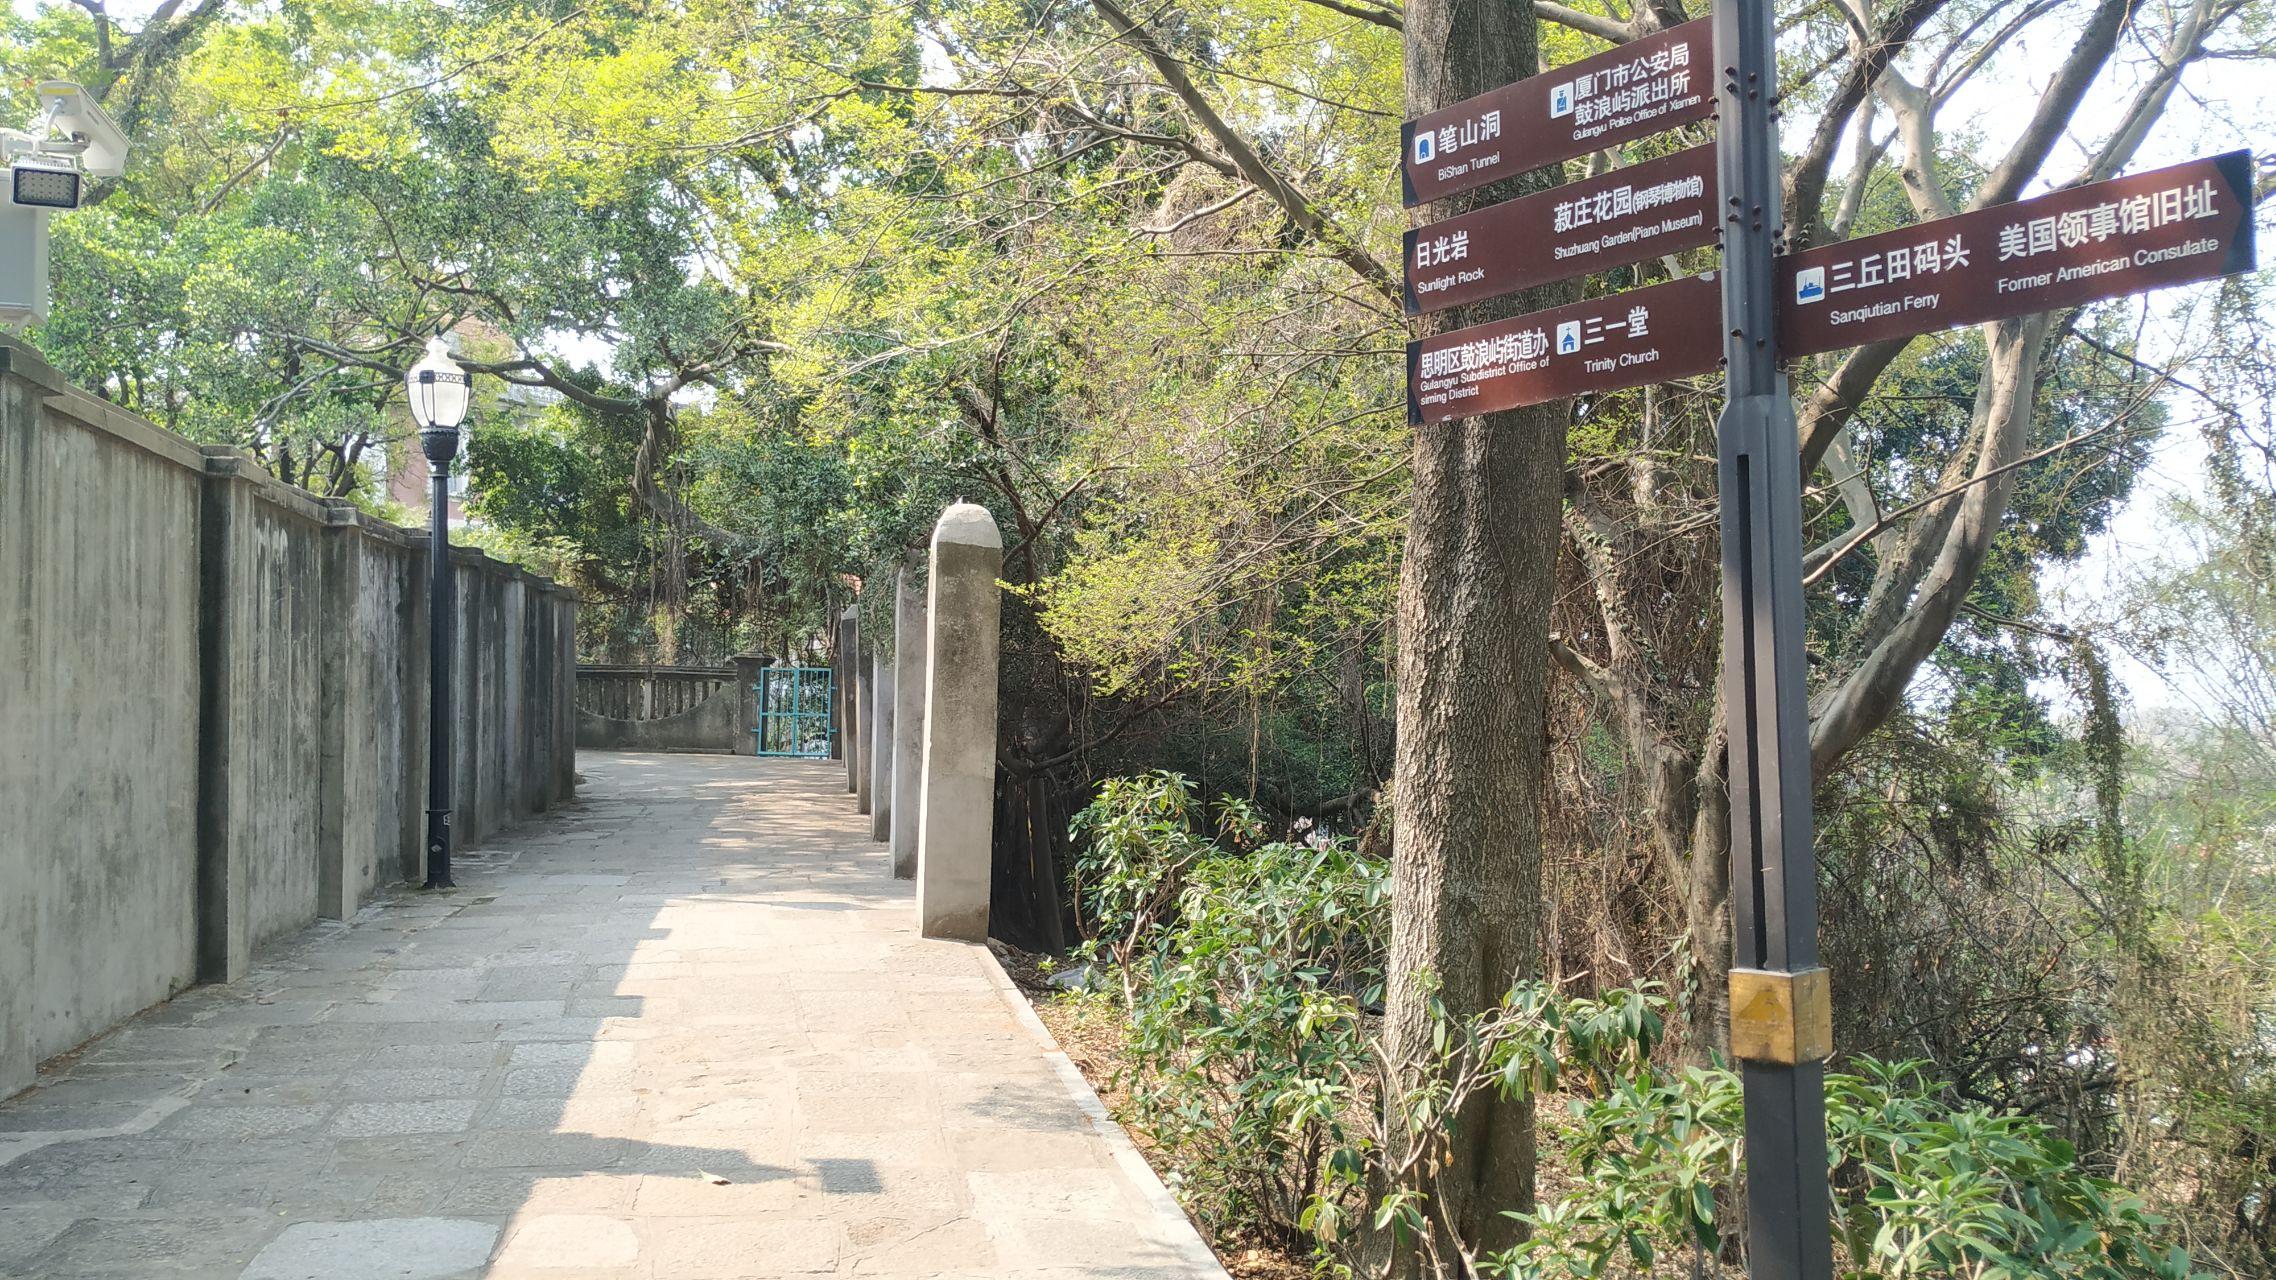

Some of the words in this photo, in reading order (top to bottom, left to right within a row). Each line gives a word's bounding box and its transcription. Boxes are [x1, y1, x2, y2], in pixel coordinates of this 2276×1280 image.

[1574, 42, 1690, 101] 厦门市公安局
[1572, 123, 1607, 141] Gulangyu
[1609, 115, 1633, 130] Police
[1633, 108, 1657, 122] Office
[1658, 105, 1668, 115] of
[1669, 95, 1701, 112] Xiamen
[1574, 69, 1691, 126] 鼓浪屿派出所
[1438, 109, 1501, 154] 笔山洞
[1438, 162, 1468, 181] BiShan
[1470, 150, 1500, 171] Tunnel
[1554, 238, 1600, 260] Shuzhuang
[1661, 209, 1703, 233] Museum)
[1998, 179, 2220, 262] 美国领事馆旧址
[1416, 230, 1470, 270] 日光岩
[1830, 233, 1971, 294] 三丘田码头
[1998, 272, 2053, 295] Former
[2055, 255, 2130, 283] American
[2134, 236, 2219, 267] Consulate
[1417, 273, 1457, 294] Sunlight
[1458, 266, 1485, 284] Rock
[1583, 305, 1650, 345] 三一堂
[1829, 300, 1901, 326] Sanqiutian
[1904, 292, 1941, 311] Ferry
[1420, 326, 1550, 379] 思明区鼓浪屿街道办
[1420, 375, 1459, 392] Gulangyu
[1460, 364, 1507, 384] Subdistrict
[1508, 359, 1538, 375] Office
[1539, 355, 1550, 368] of
[1583, 356, 1617, 373] Trinity
[1619, 347, 1660, 368] Church
[1420, 391, 1447, 406] siming
[1449, 384, 1480, 400] District
